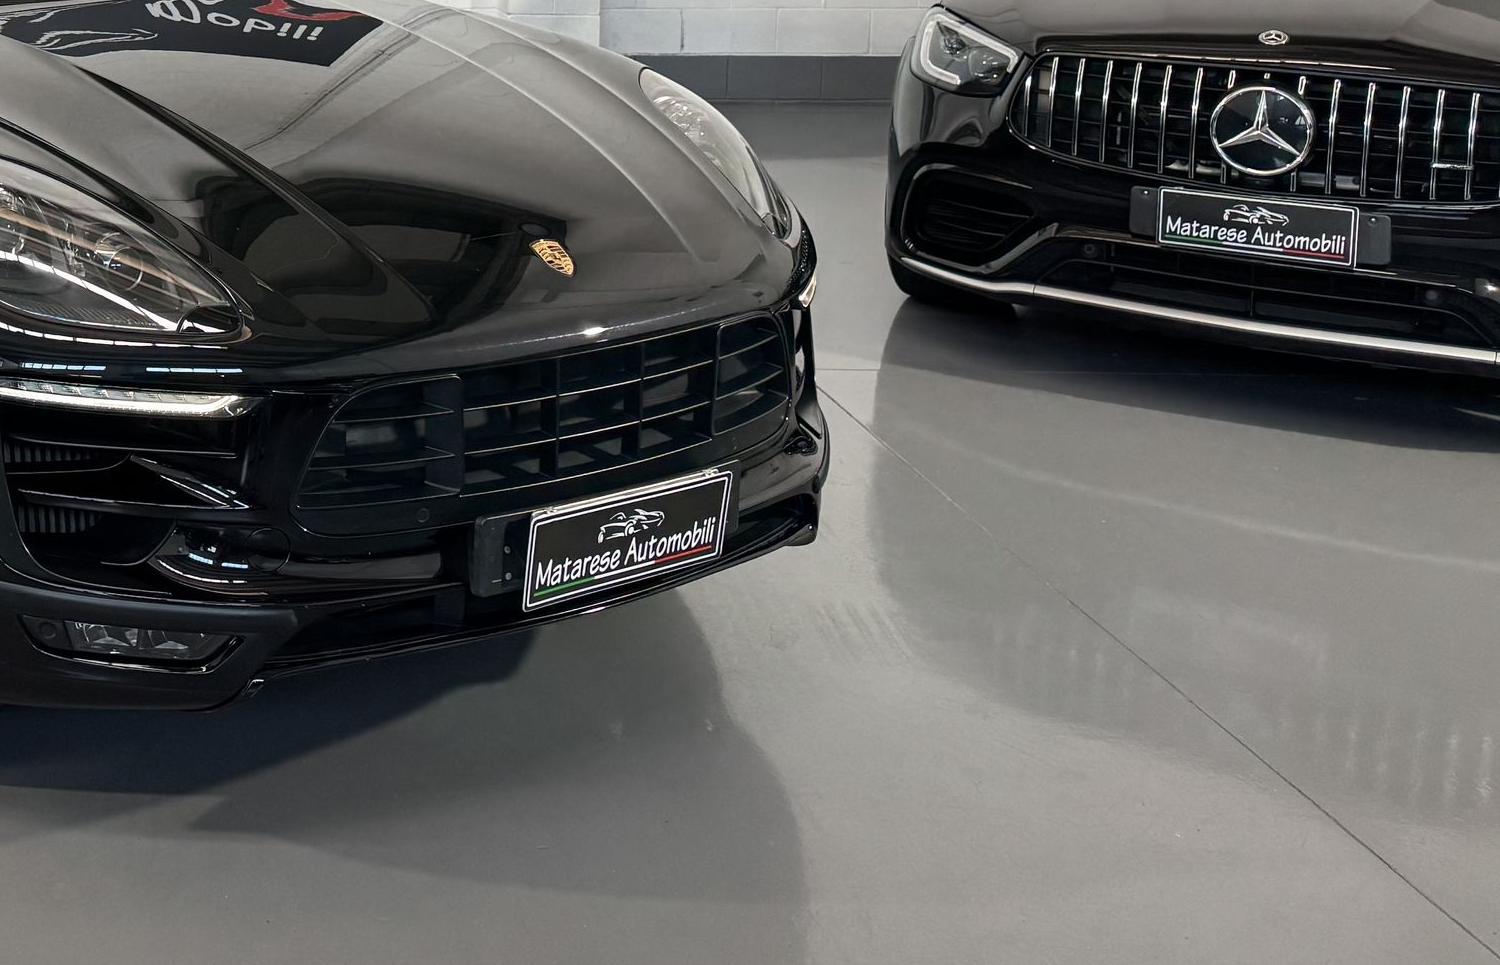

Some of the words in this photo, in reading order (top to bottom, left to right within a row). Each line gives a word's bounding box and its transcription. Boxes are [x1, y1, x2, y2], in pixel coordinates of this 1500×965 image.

[1165, 215, 1247, 242] Matarese
[1251, 226, 1346, 256] Automobili
[535, 546, 621, 590] Matarese
[624, 516, 716, 564] Automobili
